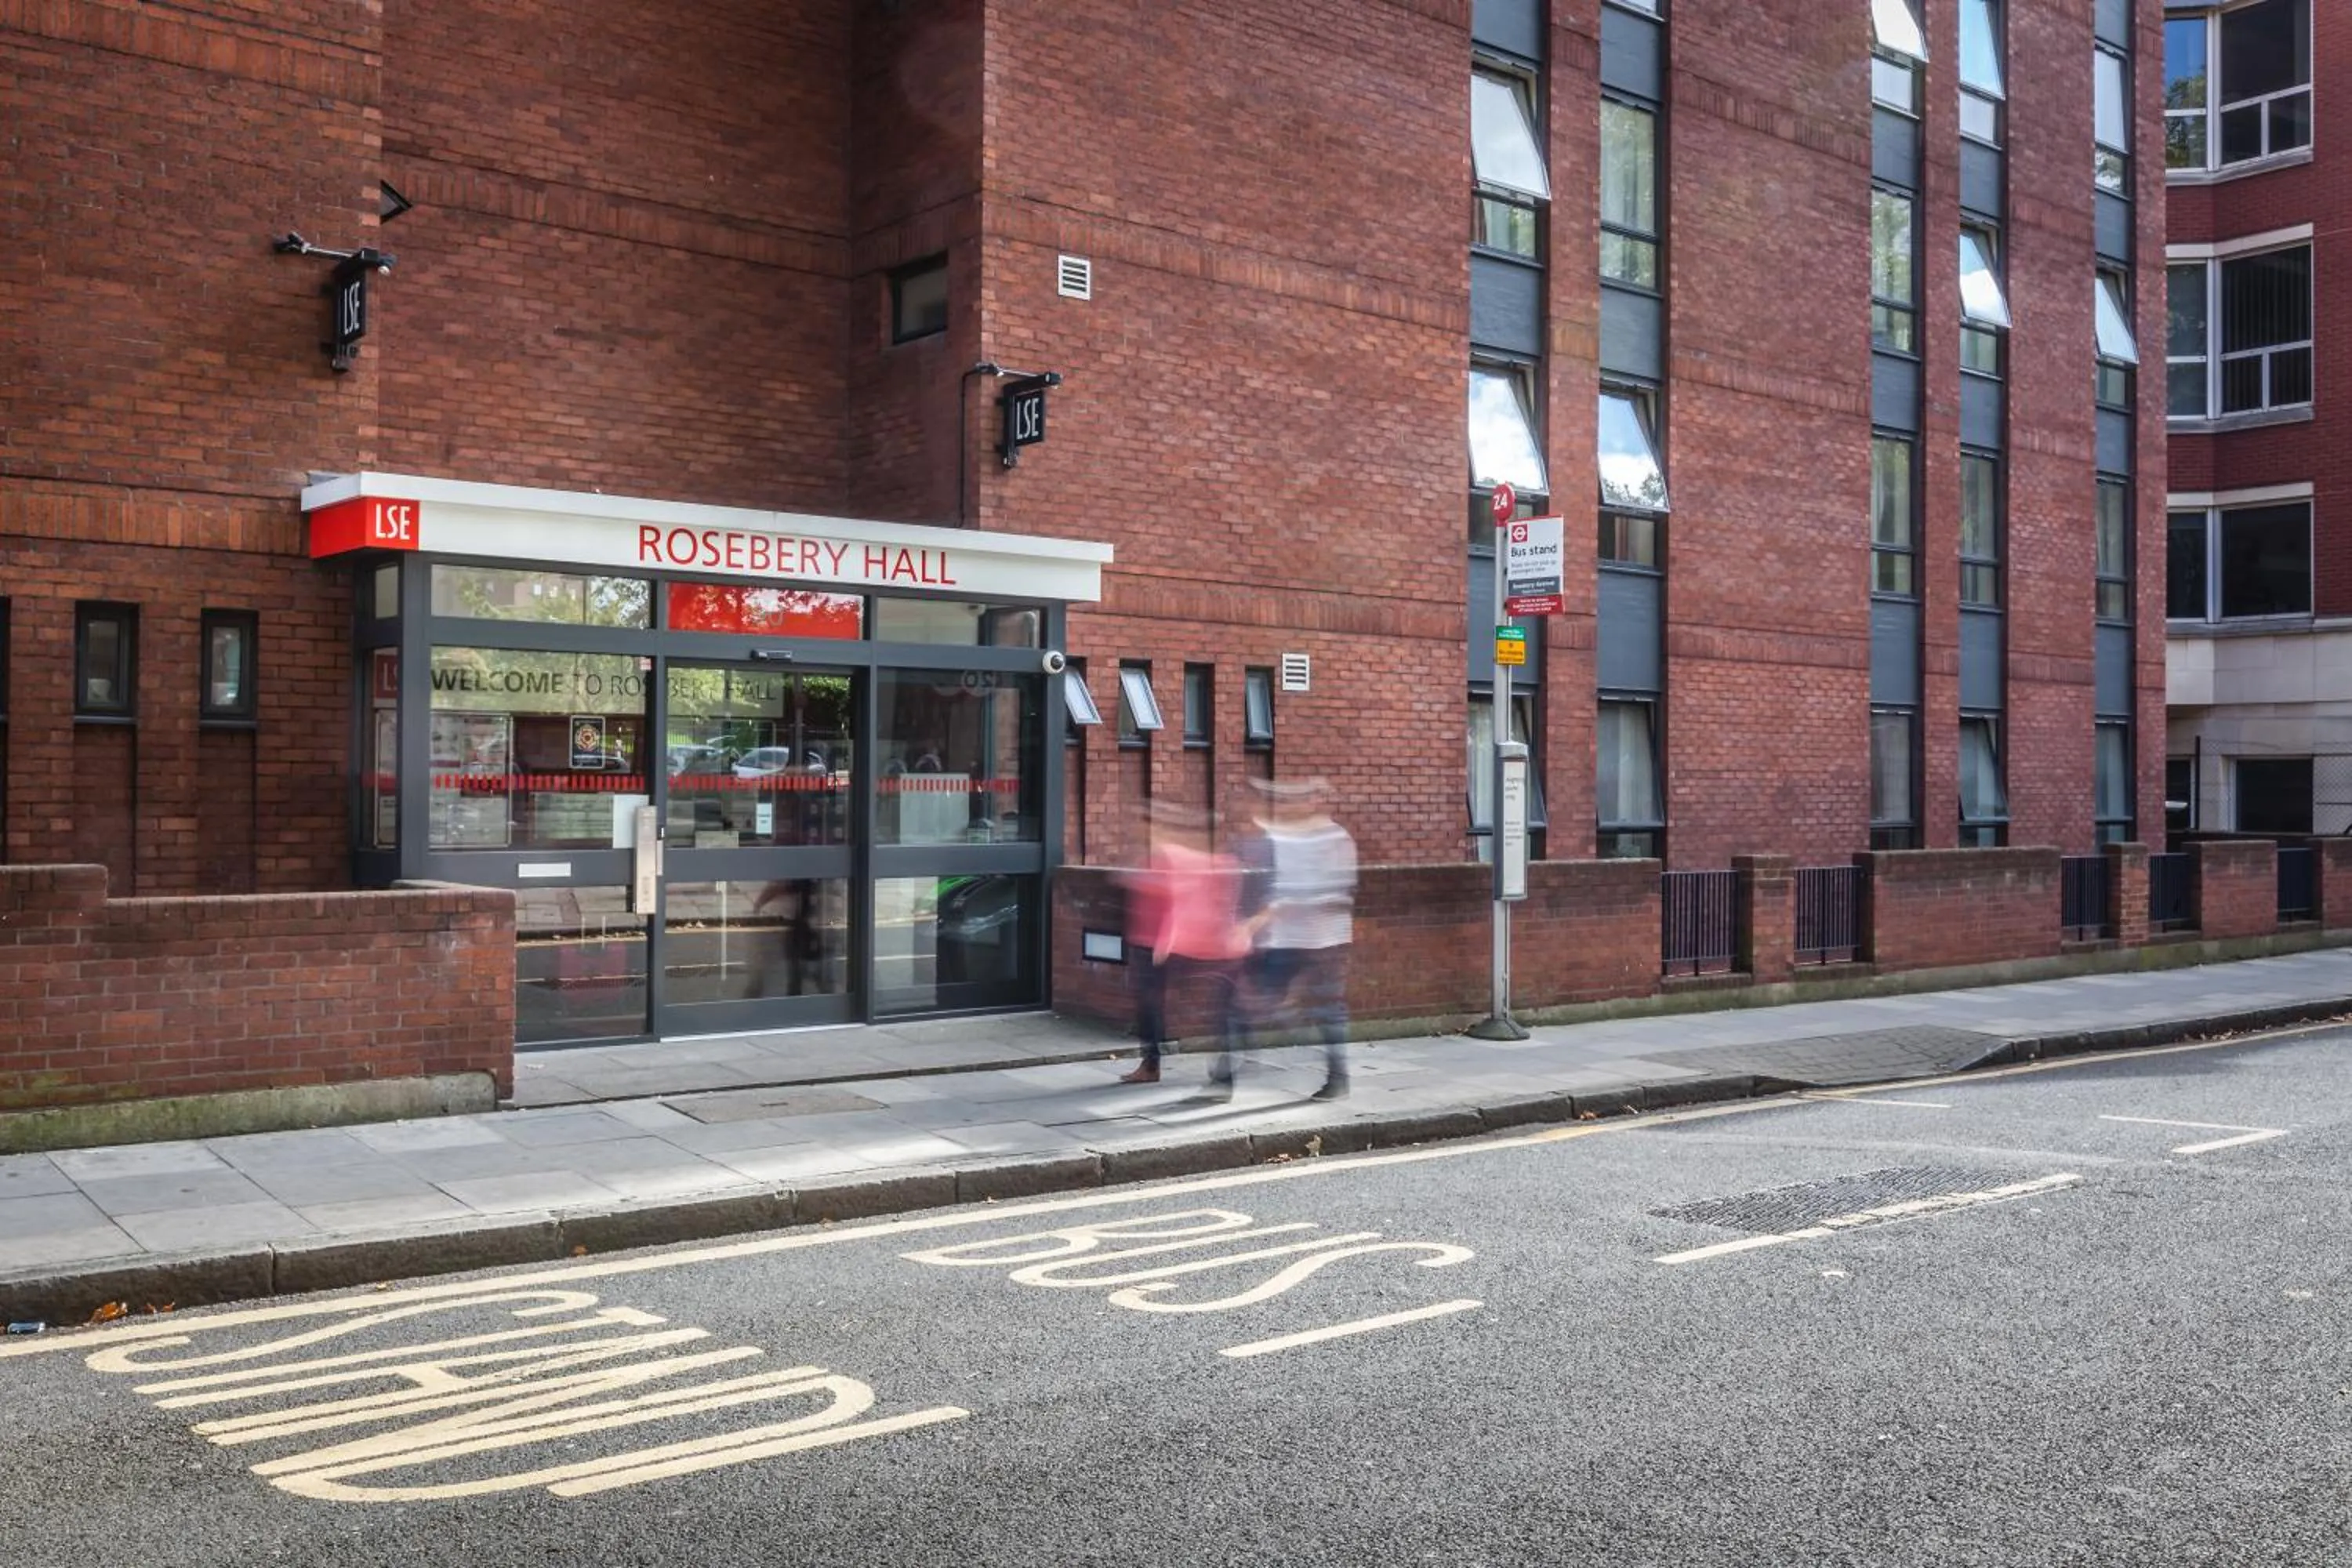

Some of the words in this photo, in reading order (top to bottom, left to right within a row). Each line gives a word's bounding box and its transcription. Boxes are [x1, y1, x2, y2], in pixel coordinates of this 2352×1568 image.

[343, 281, 361, 334] LSE
[1016, 397, 1039, 439] LSE
[375, 503, 411, 540] LSE
[638, 525, 849, 576] ROSEBERY
[865, 545, 956, 586] HALL
[1511, 547, 1526, 557] Bus
[1530, 544, 1557, 556] stand
[431, 668, 564, 693] WELCOME
[573, 673, 603, 696] TO
[898, 1208, 1475, 1313] BUS
[85, 1290, 876, 1503] STAND
